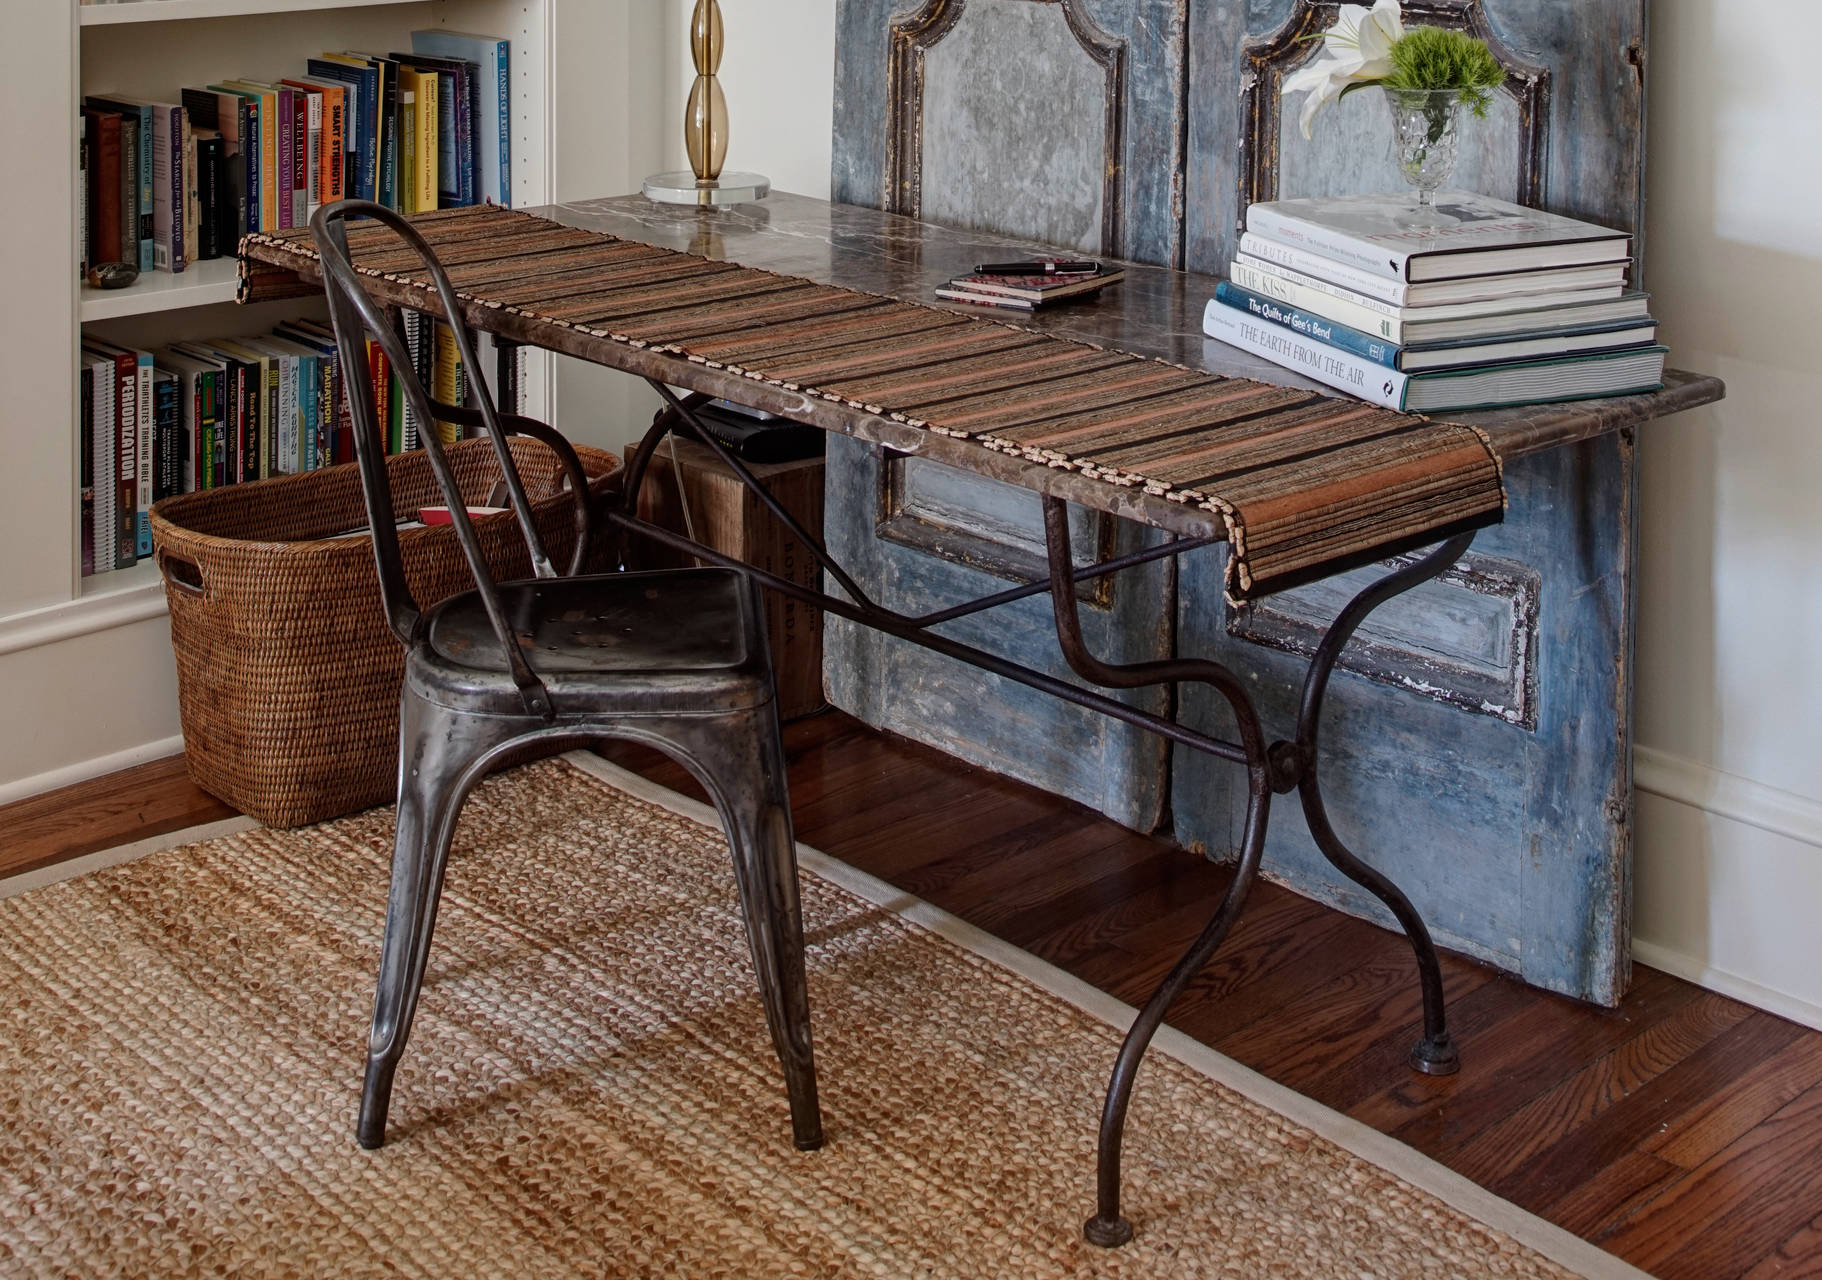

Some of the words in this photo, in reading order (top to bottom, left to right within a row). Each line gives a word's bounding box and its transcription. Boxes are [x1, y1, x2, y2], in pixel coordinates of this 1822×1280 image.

[500, 103, 507, 112] OF
[385, 117, 394, 140] DESIGNING
[296, 112, 304, 180] WELLBEING
[366, 138, 375, 157] Positive
[385, 142, 394, 161] POSITIVE
[366, 158, 375, 185] Psychology
[385, 163, 394, 192] PSYCHOLOGY
[1366, 222, 1534, 240] moments
[1246, 239, 1292, 264] TRIBUTES
[1235, 266, 1260, 290] THE
[1262, 276, 1286, 300] KISS
[1248, 298, 1262, 314] The
[1262, 304, 1282, 322] Quilts
[1284, 312, 1291, 325] of
[1292, 316, 1311, 332] Gee's
[1312, 322, 1331, 340] Bend
[1240, 322, 1258, 342] THE
[1260, 331, 1291, 356] EARTH
[1293, 341, 1321, 367] FROM
[1324, 355, 1345, 377] THE
[1347, 366, 1364, 386] AIR
[268, 370, 278, 387] RUN
[141, 380, 149, 424] TRIATHLETE'S
[324, 366, 332, 424] MARATHON
[121, 375, 134, 481] PERIODIZATION
[249, 419, 256, 430] To
[141, 427, 149, 460] TRAINING
[141, 464, 149, 482] BIBLE
